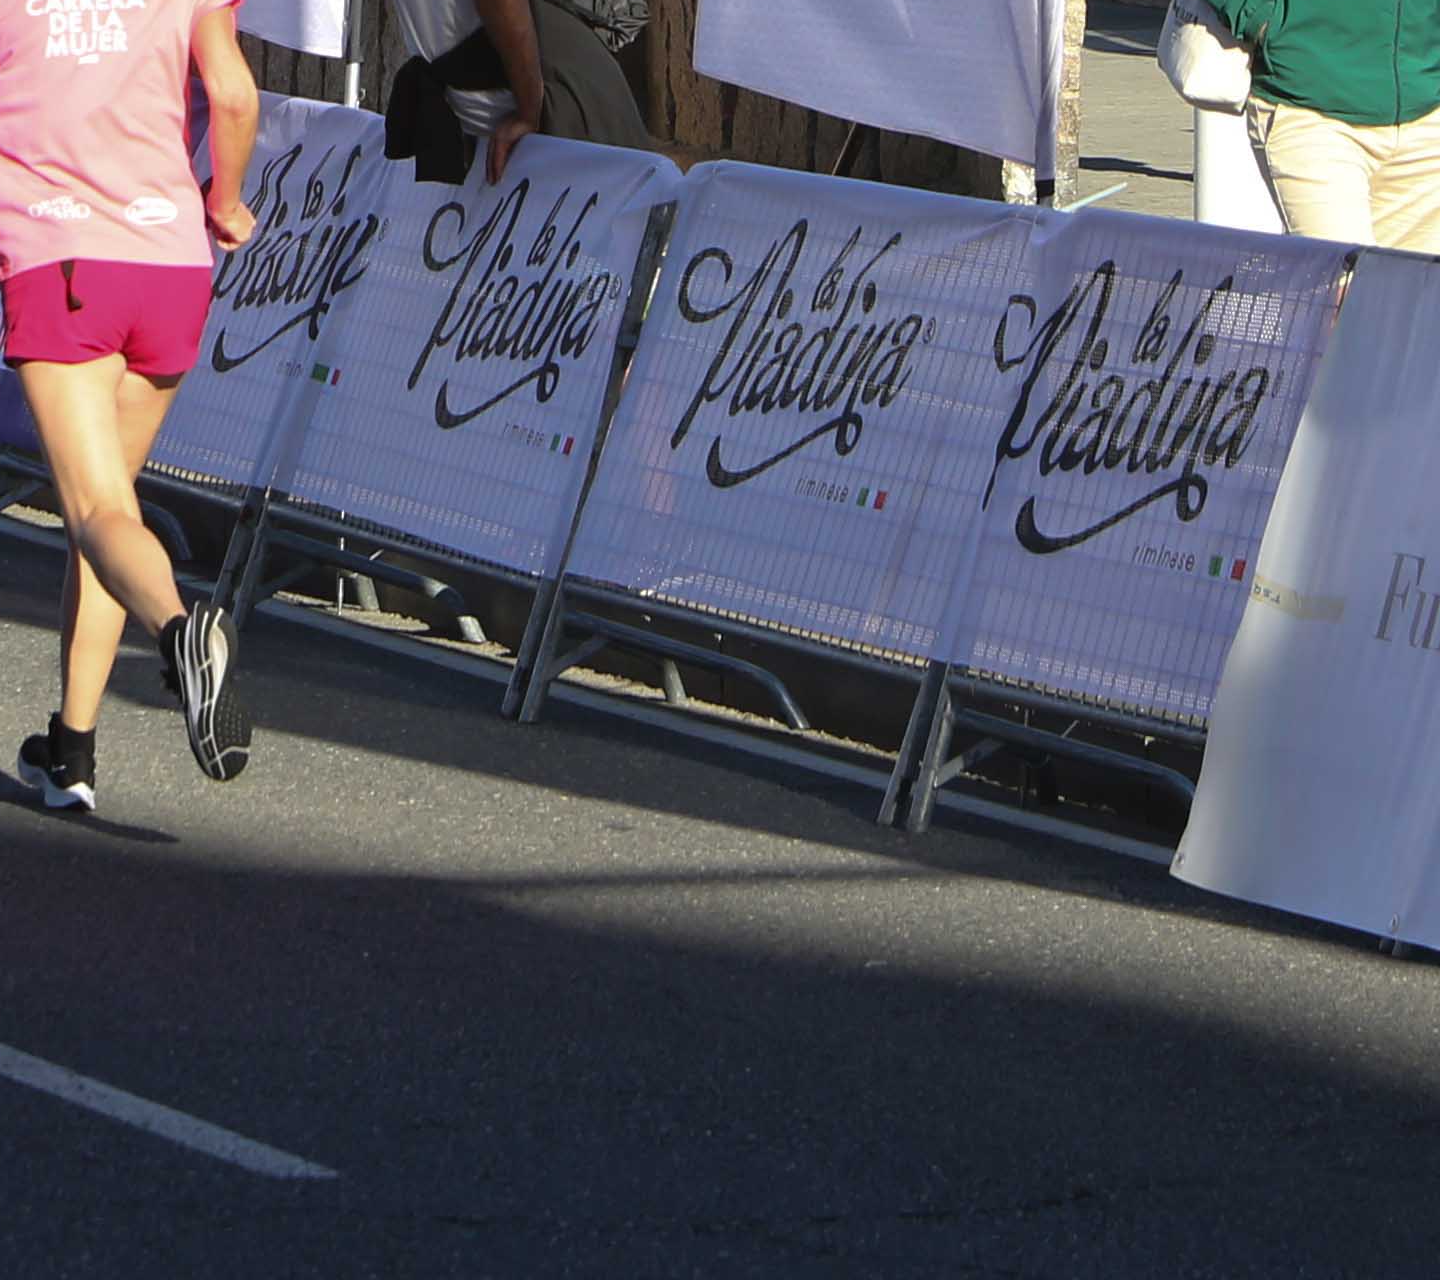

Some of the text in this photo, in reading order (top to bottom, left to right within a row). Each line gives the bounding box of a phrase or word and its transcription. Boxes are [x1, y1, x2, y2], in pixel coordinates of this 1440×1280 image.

[44, 30, 129, 58] MUJER
[48, 10, 121, 36] DE LA
[408, 177, 610, 430] Piadina
[670, 217, 924, 489] Piadina
[981, 258, 1270, 555] Piadina
[1131, 543, 1196, 573] riminese
